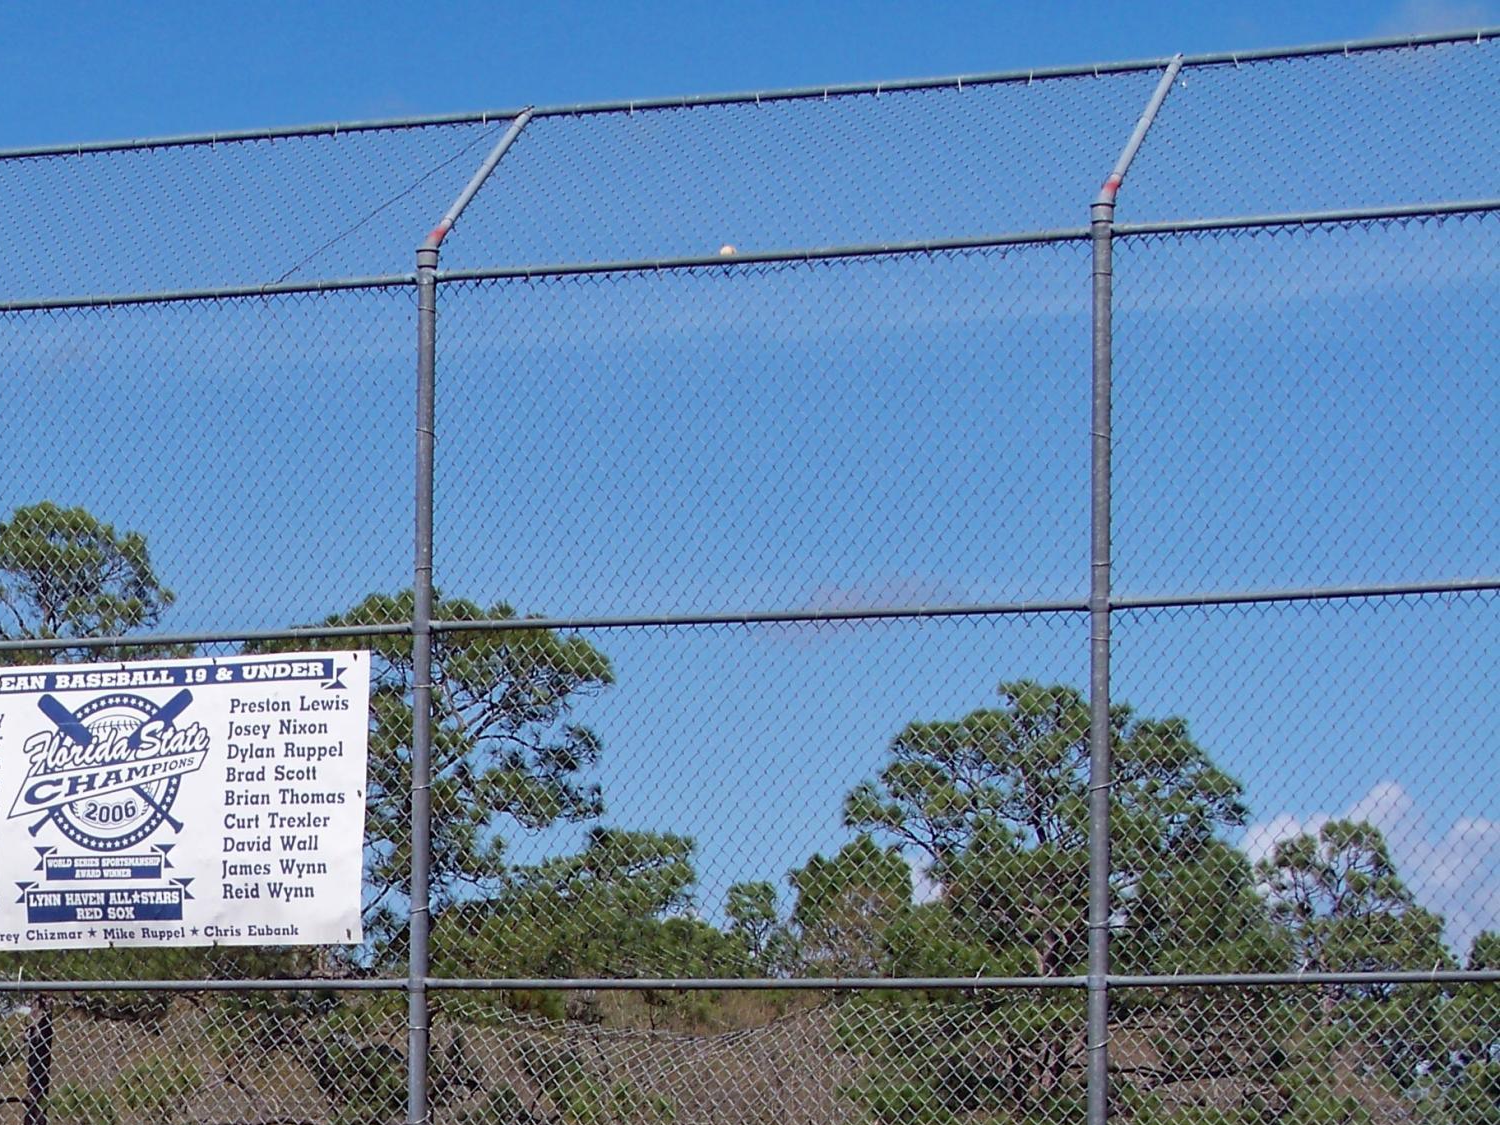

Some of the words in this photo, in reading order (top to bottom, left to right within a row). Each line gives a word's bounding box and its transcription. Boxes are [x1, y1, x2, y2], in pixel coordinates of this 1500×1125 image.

[55, 670, 174, 690] BASEBALL
[185, 668, 207, 684] 19
[215, 667, 233, 681] &
[242, 662, 324, 679] UNDER
[230, 698, 291, 713] Preston
[299, 695, 350, 711] Lewis
[228, 721, 271, 739] Josey
[279, 719, 328, 735] Nixon
[23, 728, 131, 771] Florida
[135, 720, 211, 759] State
[227, 744, 275, 762] Dylan
[284, 741, 343, 761] Ruppel
[24, 757, 194, 805] CHAMPIONS
[226, 767, 265, 782] Brad
[274, 766, 317, 781] Scott
[225, 790, 270, 806] Brian
[279, 790, 345, 805] Thomas
[85, 800, 136, 823] 2006
[224, 813, 259, 829] Curt
[268, 811, 330, 828] Trexler
[223, 837, 271, 852] David
[280, 835, 318, 851] Wall
[47, 859, 72, 867] WORLD
[74, 858, 99, 867] SERIES
[222, 860, 271, 879] James
[279, 859, 327, 877] Wynn
[29, 894, 61, 907] LYNN
[66, 893, 105, 906] HAVEN
[223, 883, 260, 899] Reid
[268, 882, 315, 902] Wynn
[76, 908, 102, 919] RED
[108, 907, 135, 919] SOX
[26, 929, 82, 941] Chizmar
[103, 929, 135, 940] Mike
[142, 927, 185, 940] Ruppel
[204, 927, 241, 937] Chris
[248, 925, 299, 936] Eubank
